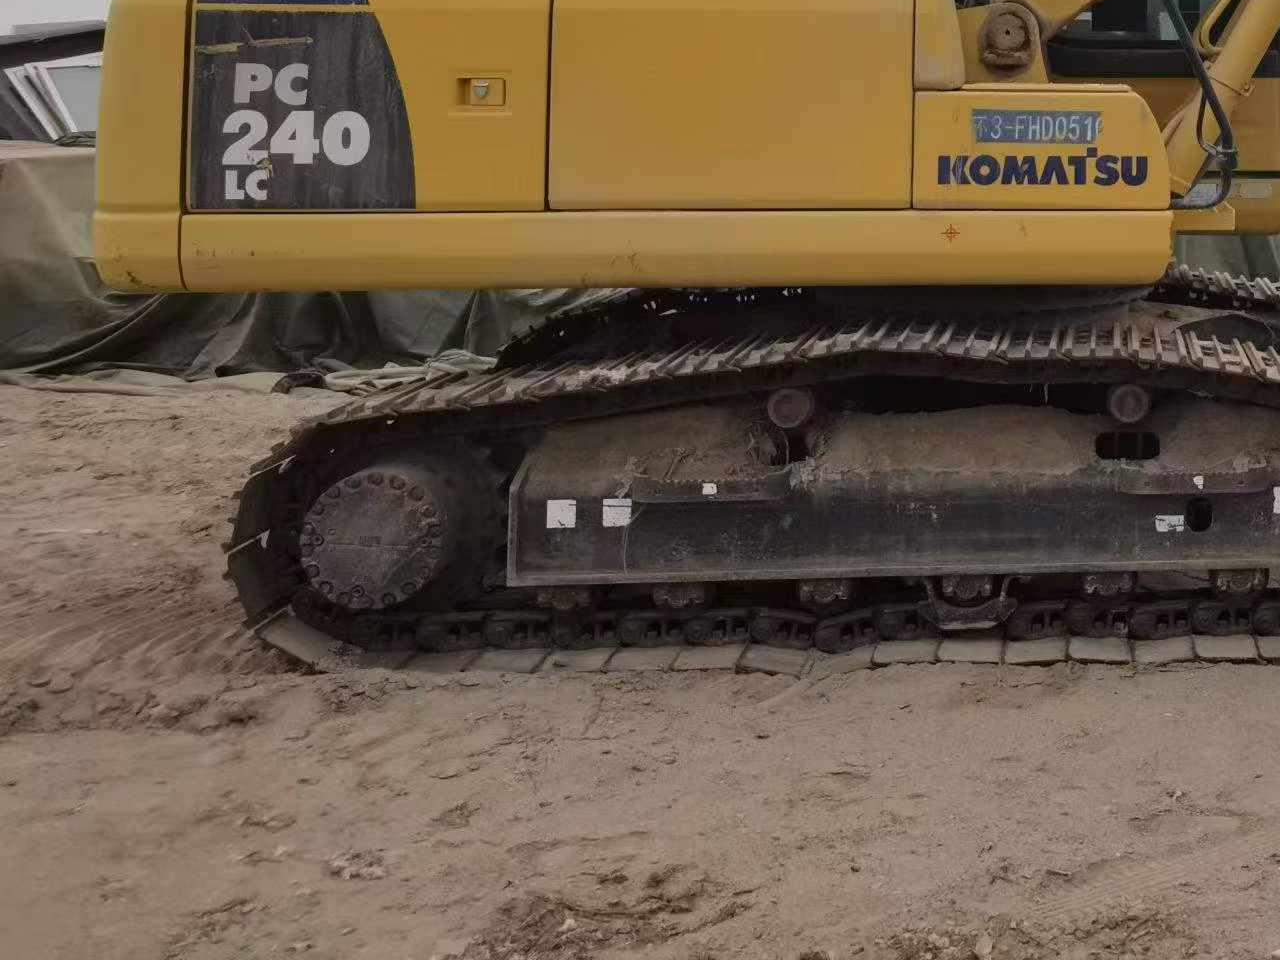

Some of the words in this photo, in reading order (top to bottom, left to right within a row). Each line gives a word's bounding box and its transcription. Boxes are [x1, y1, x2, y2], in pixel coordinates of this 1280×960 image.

[233, 62, 310, 106] PC
[221, 109, 371, 167] 240
[224, 168, 272, 201] LC
[937, 147, 1149, 187] KOMATSU
